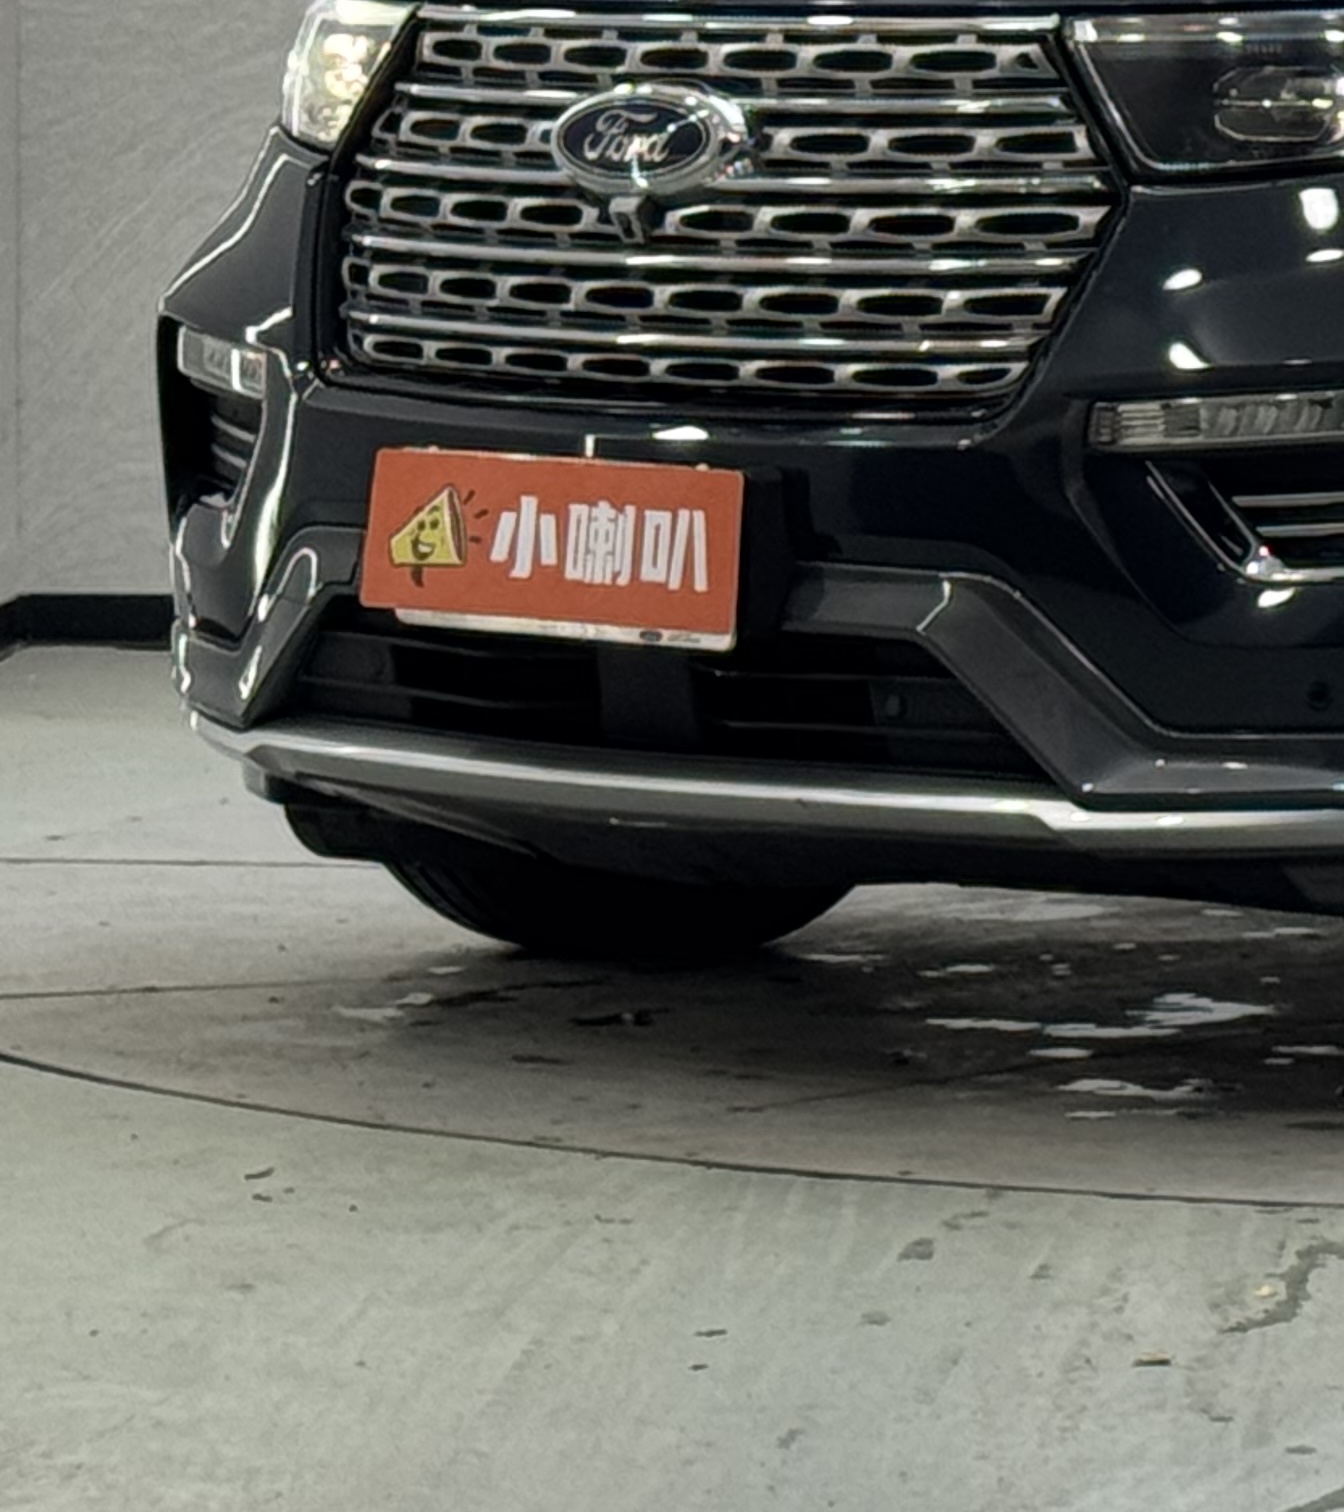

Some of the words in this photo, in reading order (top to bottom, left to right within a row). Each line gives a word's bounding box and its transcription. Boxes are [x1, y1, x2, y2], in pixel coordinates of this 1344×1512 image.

[582, 109, 672, 162] Ford
[490, 496, 709, 593] 小喇叭
